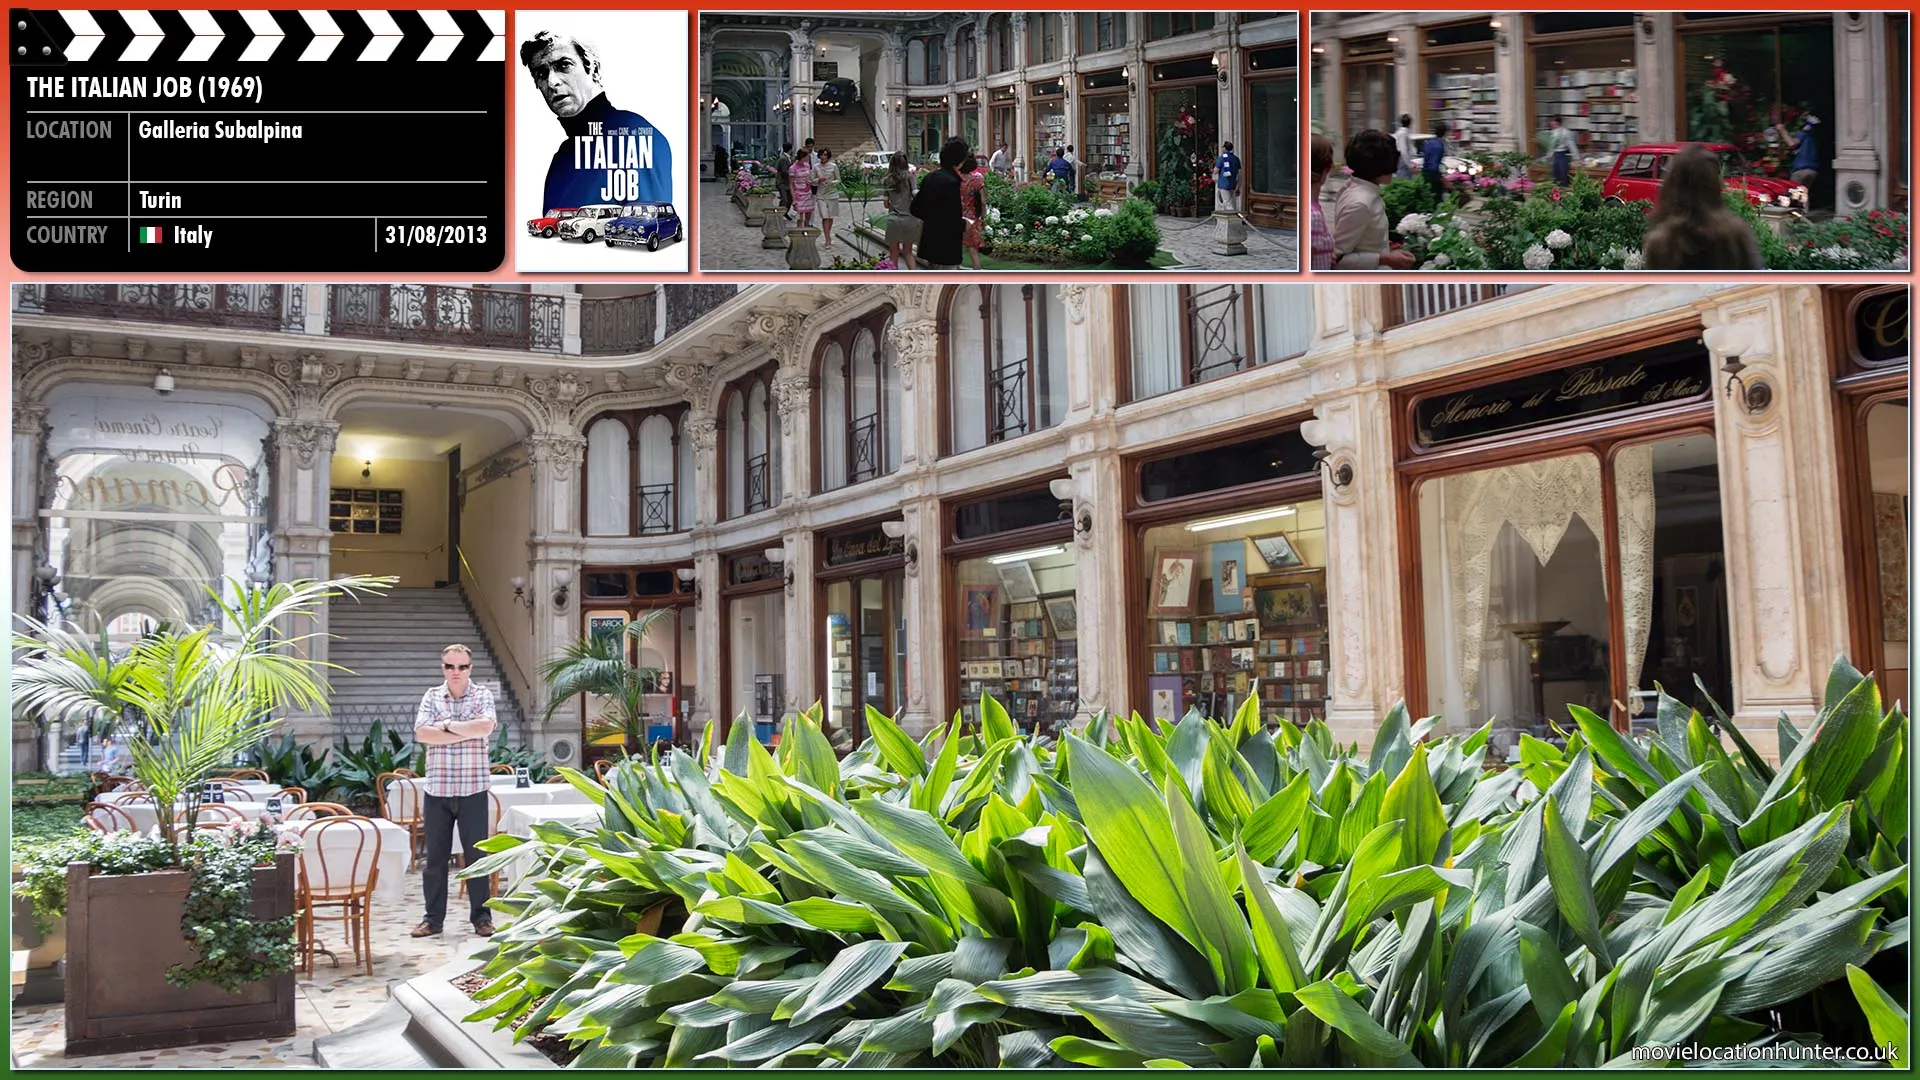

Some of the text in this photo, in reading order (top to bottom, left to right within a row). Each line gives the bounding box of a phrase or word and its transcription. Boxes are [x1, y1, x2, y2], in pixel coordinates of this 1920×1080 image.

[588, 121, 604, 136] THE
[574, 135, 653, 169] ITALIAN
[600, 169, 639, 202] JOB
[1431, 365, 1648, 428] Memorie del Passato
